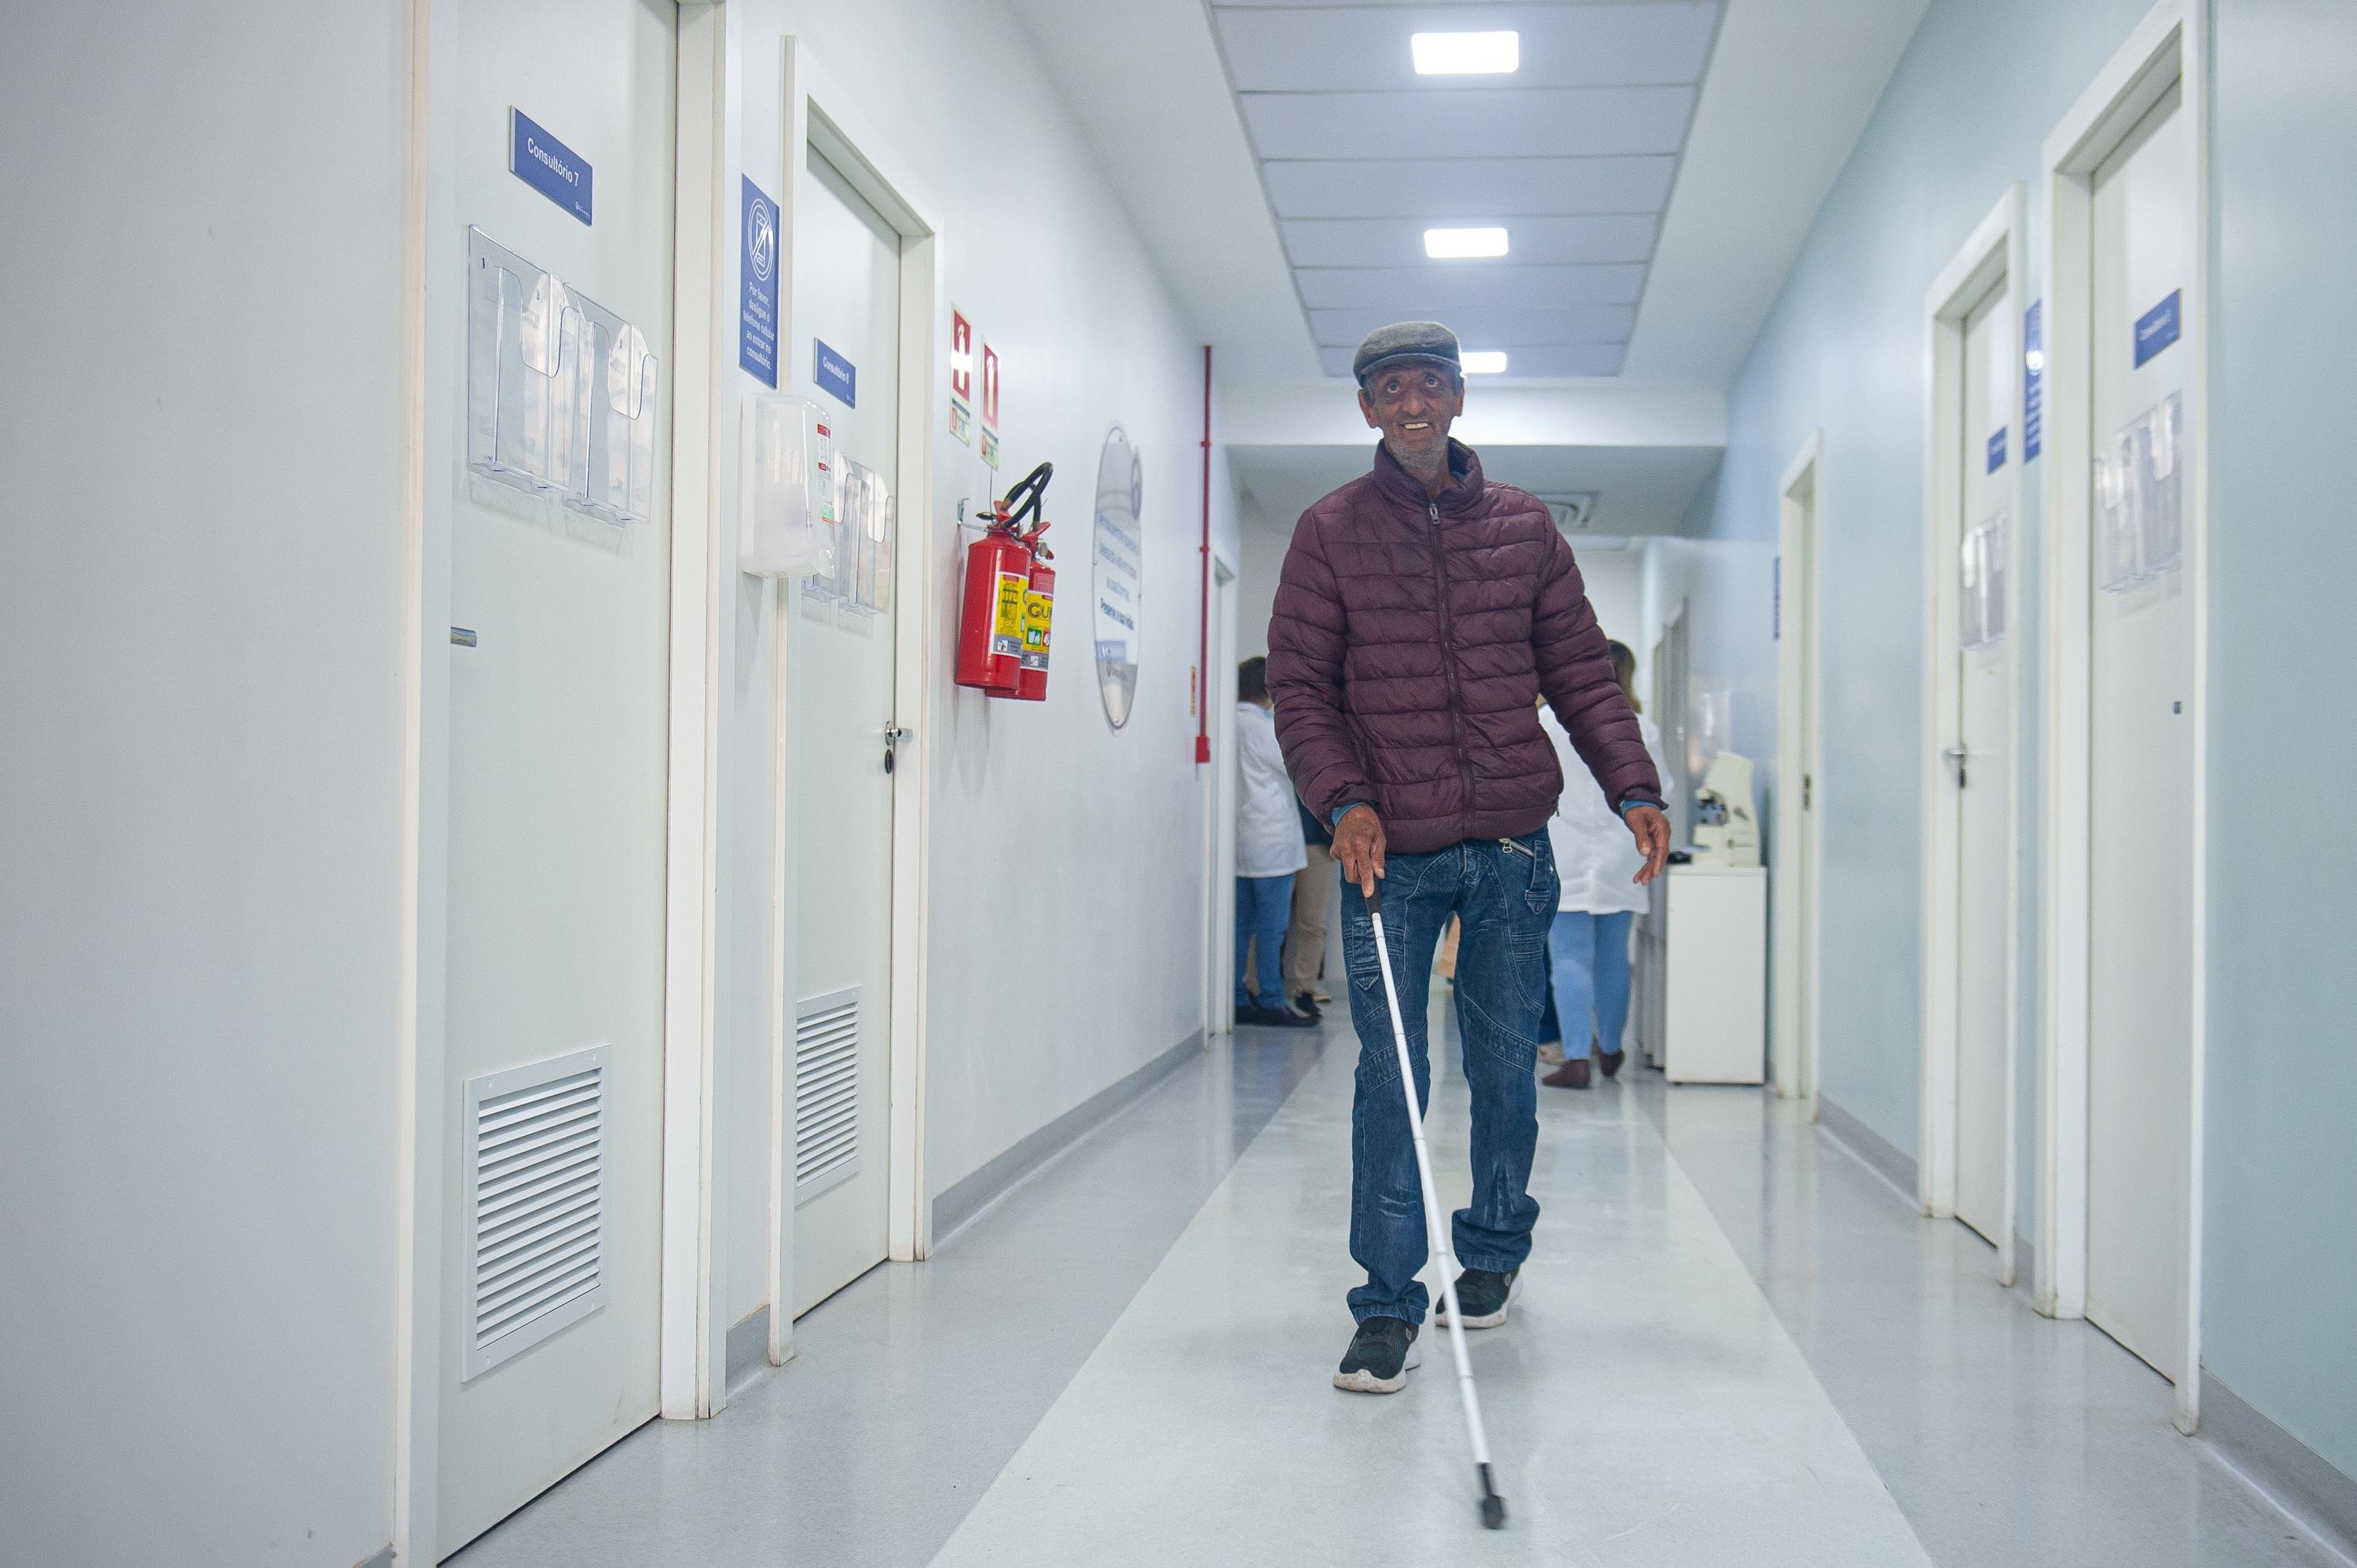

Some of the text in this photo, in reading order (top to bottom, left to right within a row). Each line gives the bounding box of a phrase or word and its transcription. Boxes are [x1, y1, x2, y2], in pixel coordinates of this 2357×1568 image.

[528, 137, 579, 187] Consultório 7
[749, 282, 757, 298] Por
[749, 299, 767, 320] desligue
[743, 310, 775, 341] telefone celular
[746, 330, 772, 354] ao entrar no
